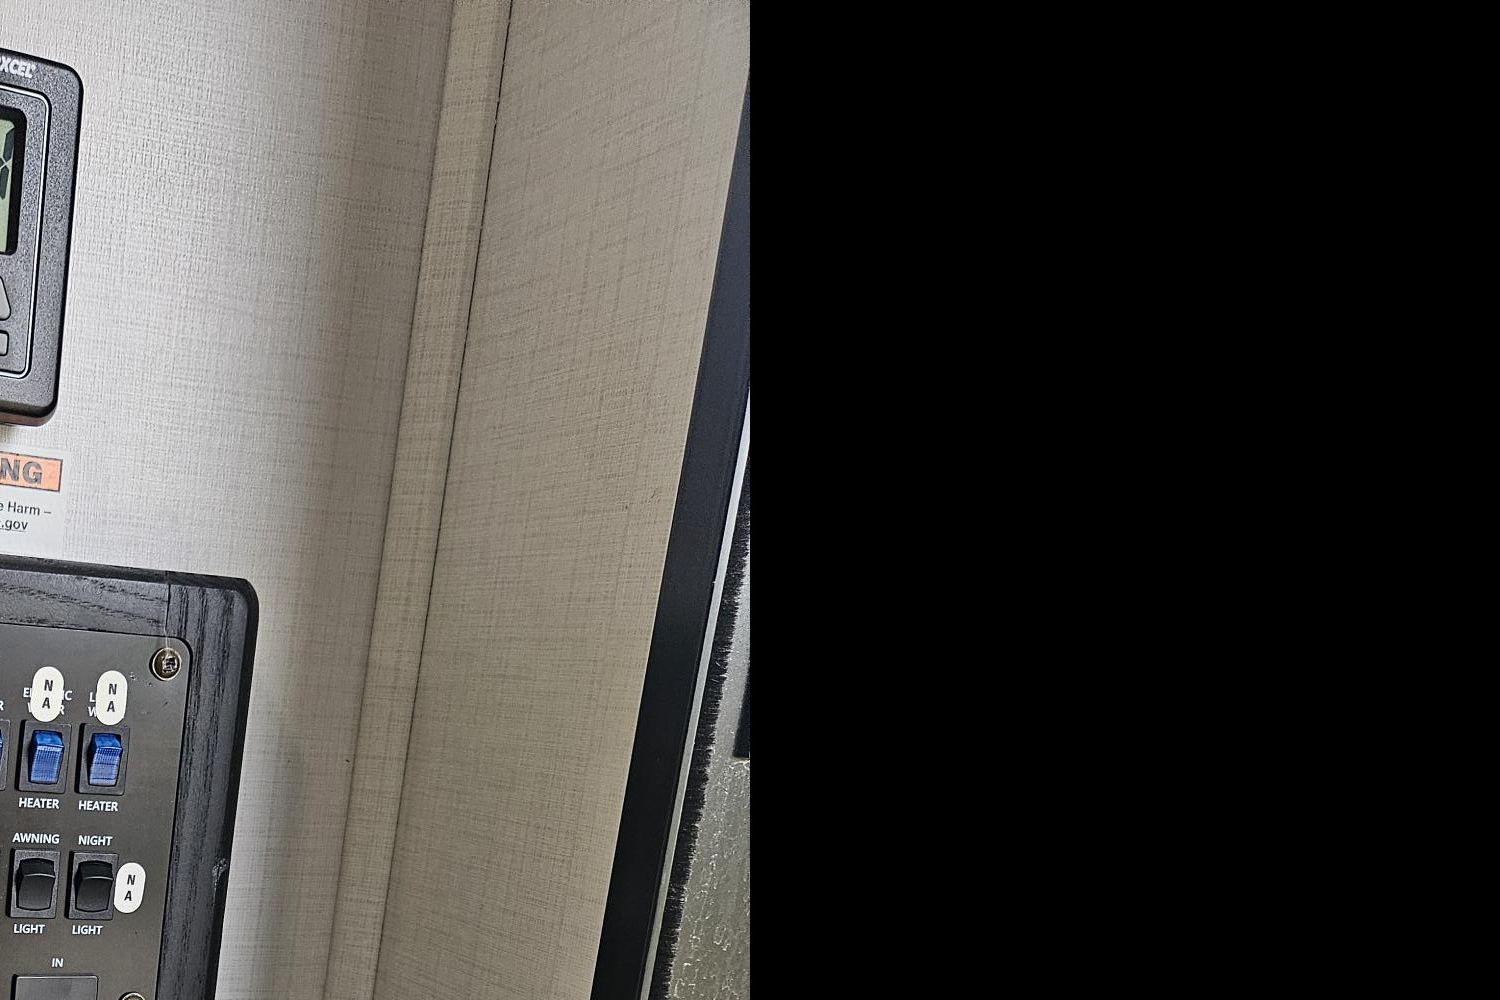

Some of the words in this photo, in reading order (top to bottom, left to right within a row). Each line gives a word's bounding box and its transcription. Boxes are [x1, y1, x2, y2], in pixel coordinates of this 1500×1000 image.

[7, 501, 41, 516] Harm
[18, 798, 60, 810] HEATER
[78, 800, 119, 812] HEATER
[12, 832, 60, 845] AWNING
[78, 835, 113, 846] NIGHT
[13, 923, 45, 934] LIGHT
[71, 925, 103, 935] LIGHT
[52, 958, 64, 968] IN
